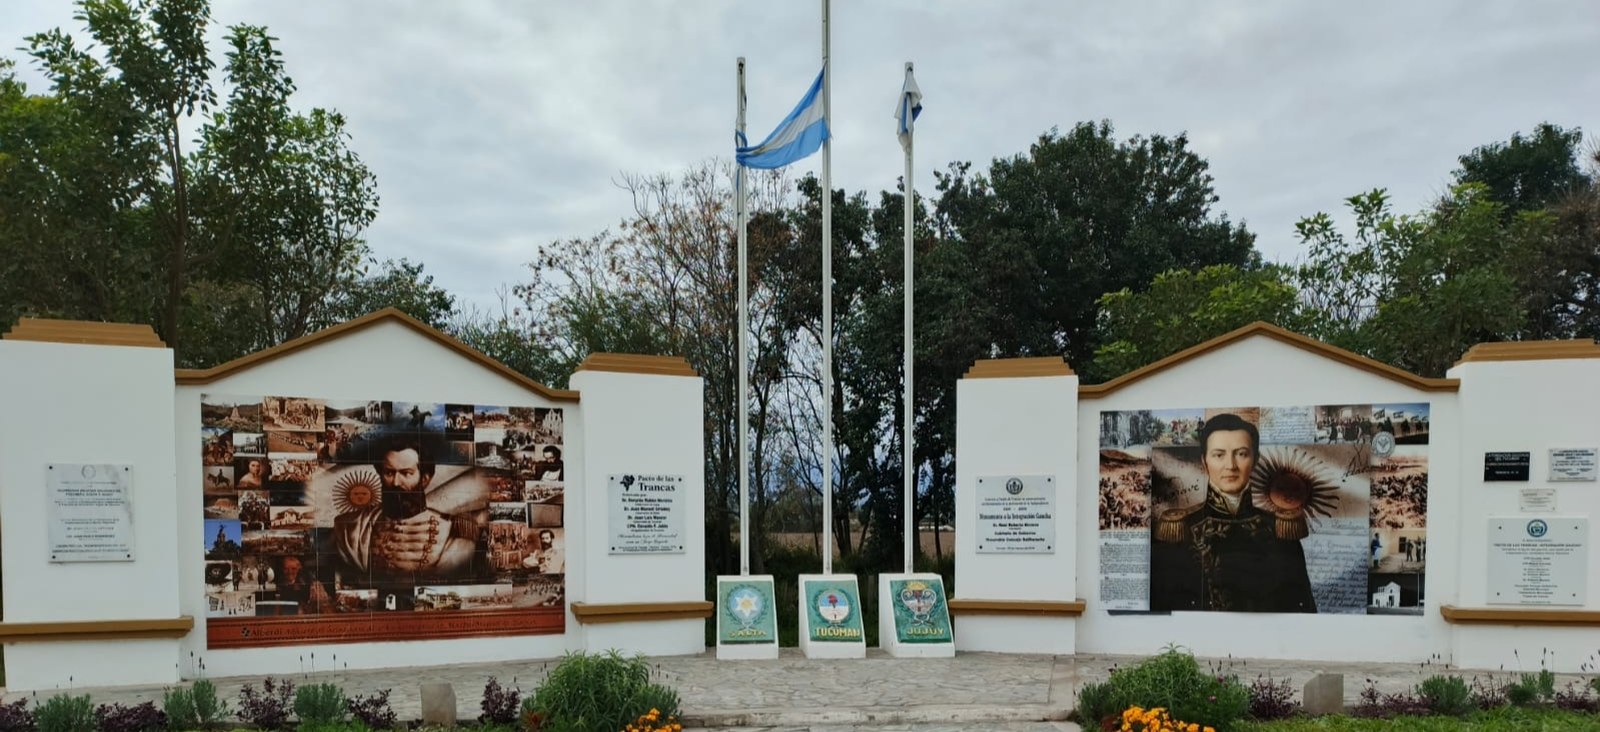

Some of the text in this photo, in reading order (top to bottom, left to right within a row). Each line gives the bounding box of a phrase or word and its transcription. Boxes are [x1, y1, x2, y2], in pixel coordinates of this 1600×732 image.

[638, 482, 676, 492] Trancas
[728, 630, 767, 638] SALTA
[815, 627, 861, 637] TUCUMAN
[907, 627, 944, 635] JUJUY
